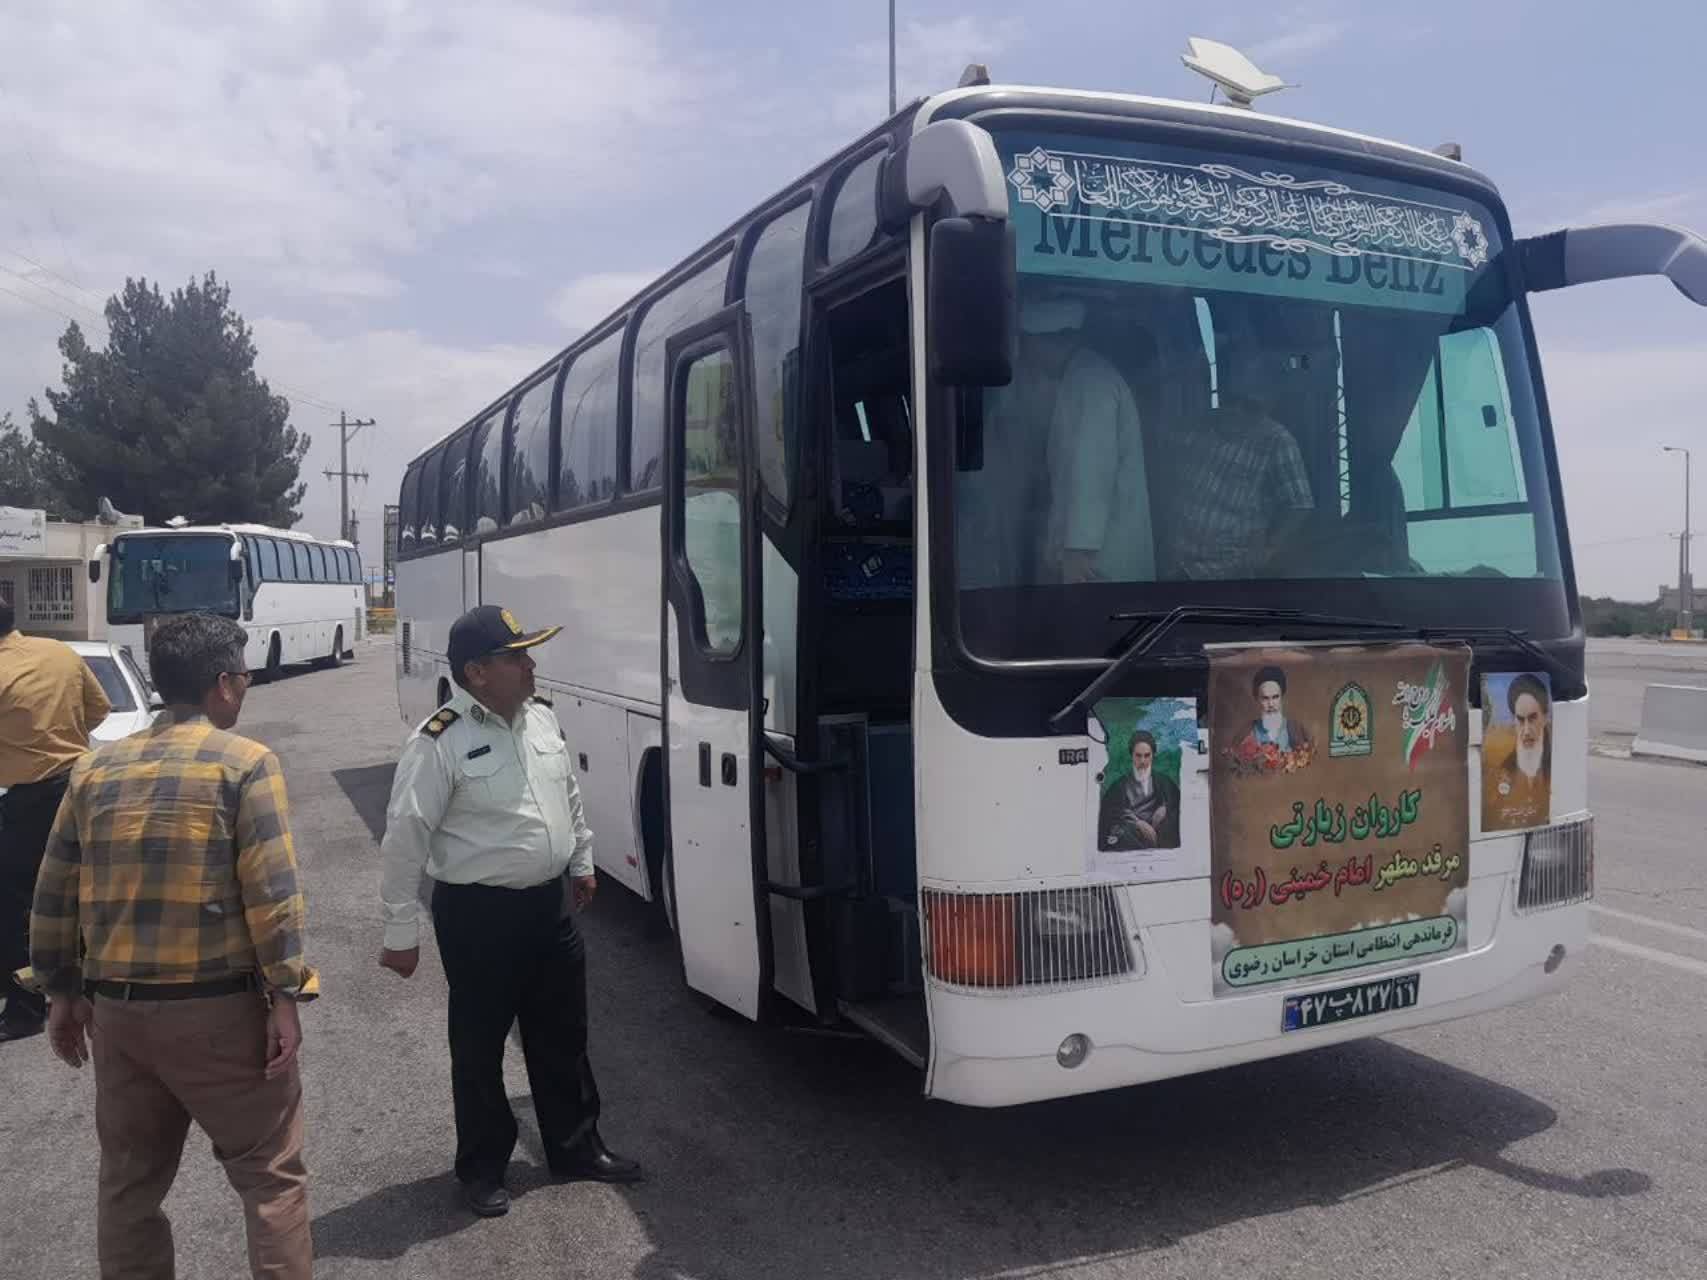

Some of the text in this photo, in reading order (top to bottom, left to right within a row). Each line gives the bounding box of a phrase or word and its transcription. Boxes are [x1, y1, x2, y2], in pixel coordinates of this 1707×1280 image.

[1061, 751, 1088, 763] IRA
[1270, 789, 1422, 849] کاروان زیارتی
[1221, 844, 1461, 909] مرقد مطهر امام خمینی (ره)
[1228, 924, 1454, 979] فرماندهی انتظامی استان خراسان رضوی
